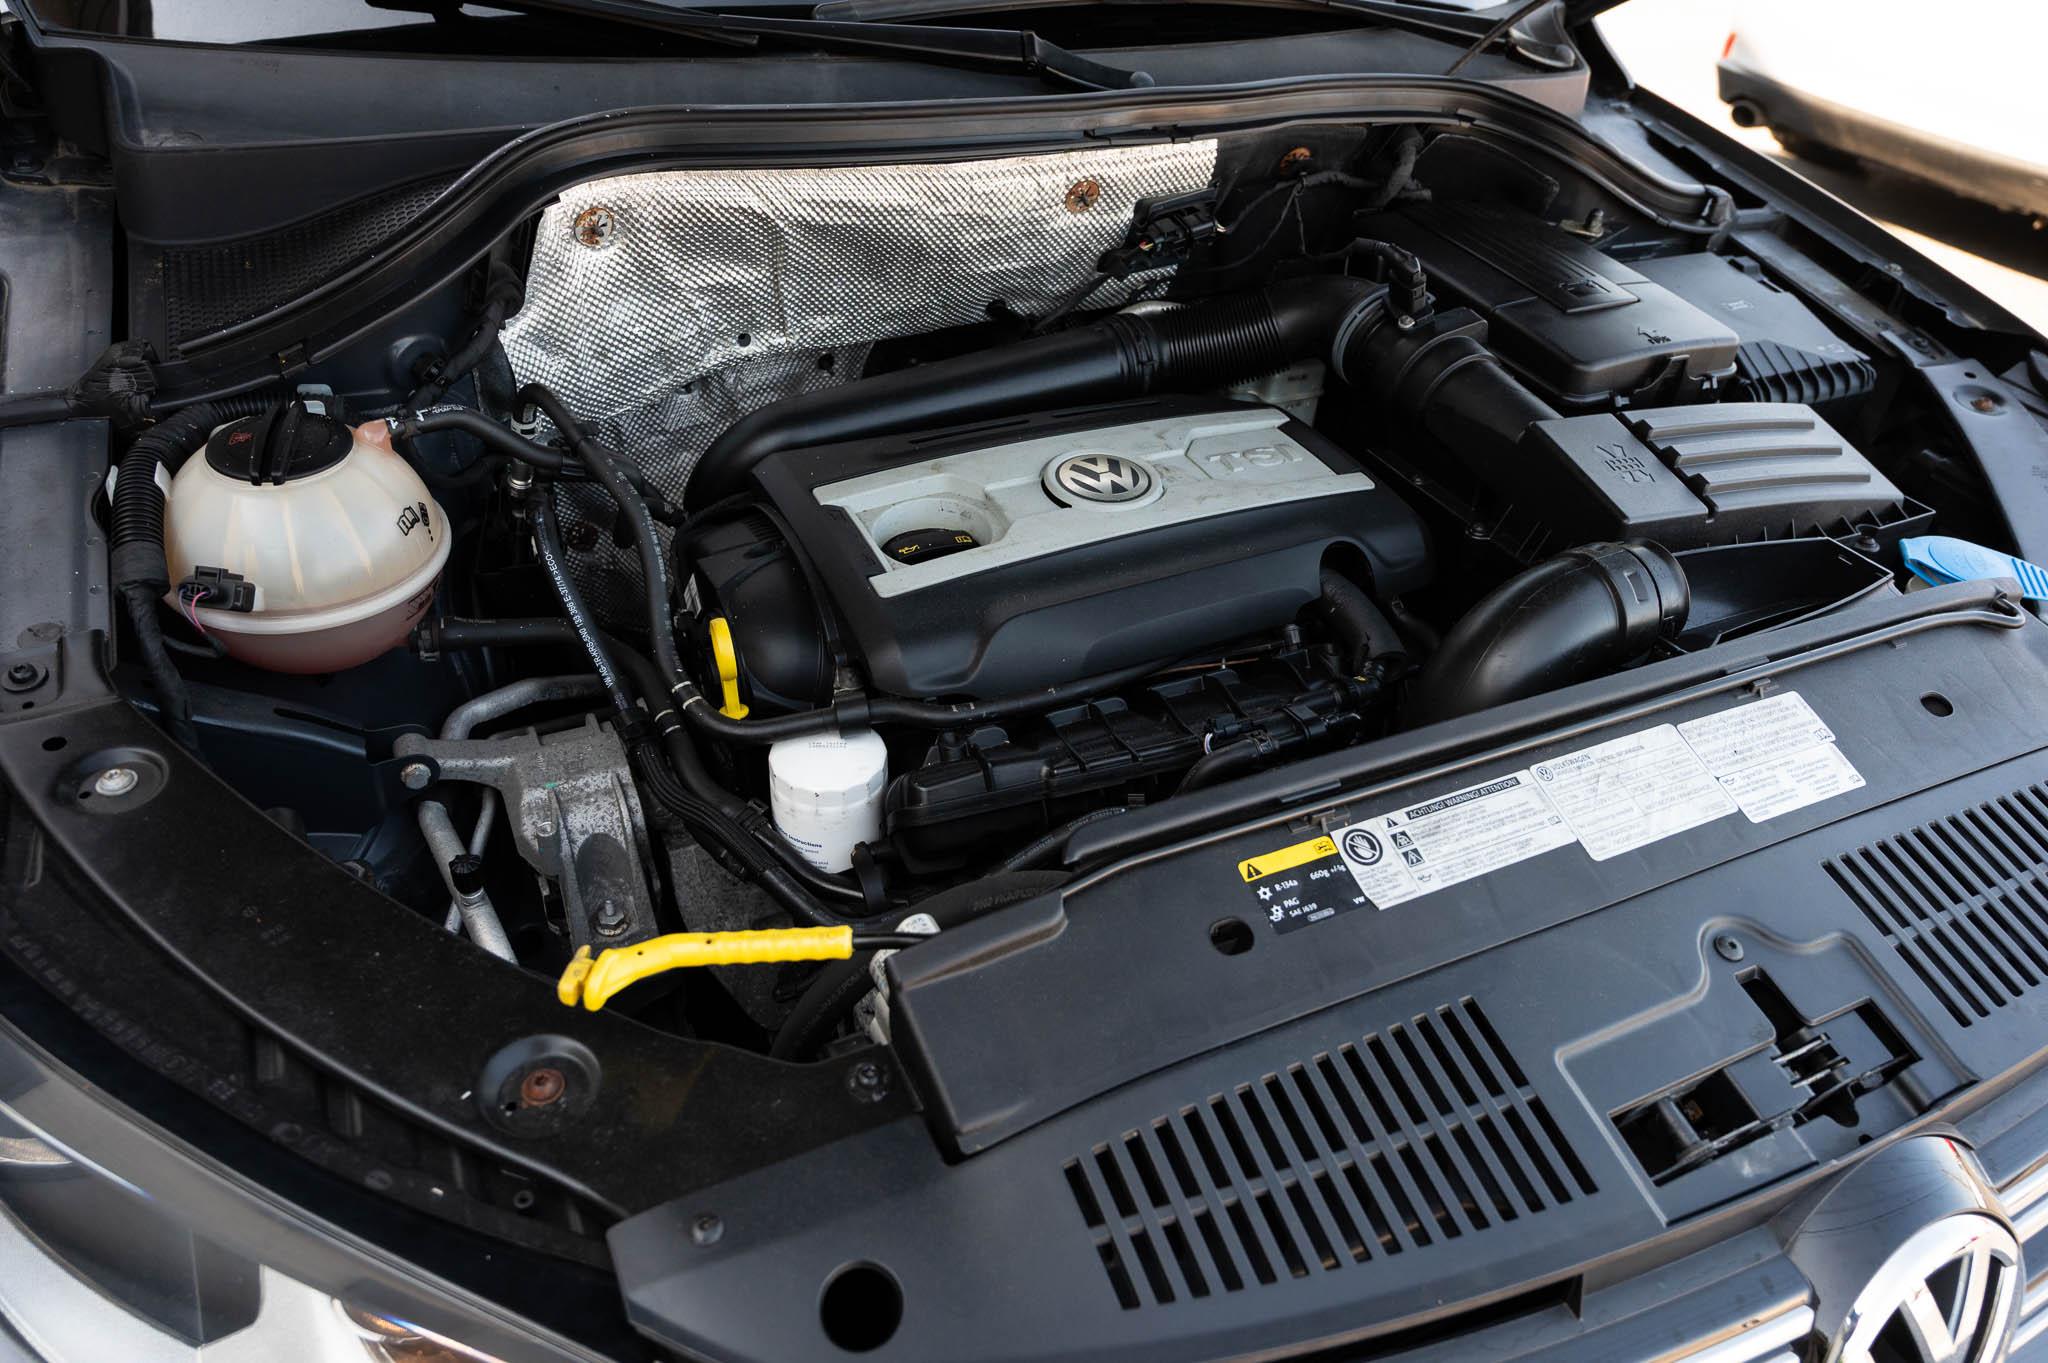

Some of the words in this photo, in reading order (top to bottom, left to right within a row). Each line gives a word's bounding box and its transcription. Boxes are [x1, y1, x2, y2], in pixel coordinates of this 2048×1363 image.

[1207, 442, 1303, 473] TSI
[1409, 801, 1446, 819] ACHTUNG!
[1445, 790, 1481, 807] WARNING!
[1480, 777, 1518, 796] ATTENTION!
[1282, 896, 1300, 909] PAG
